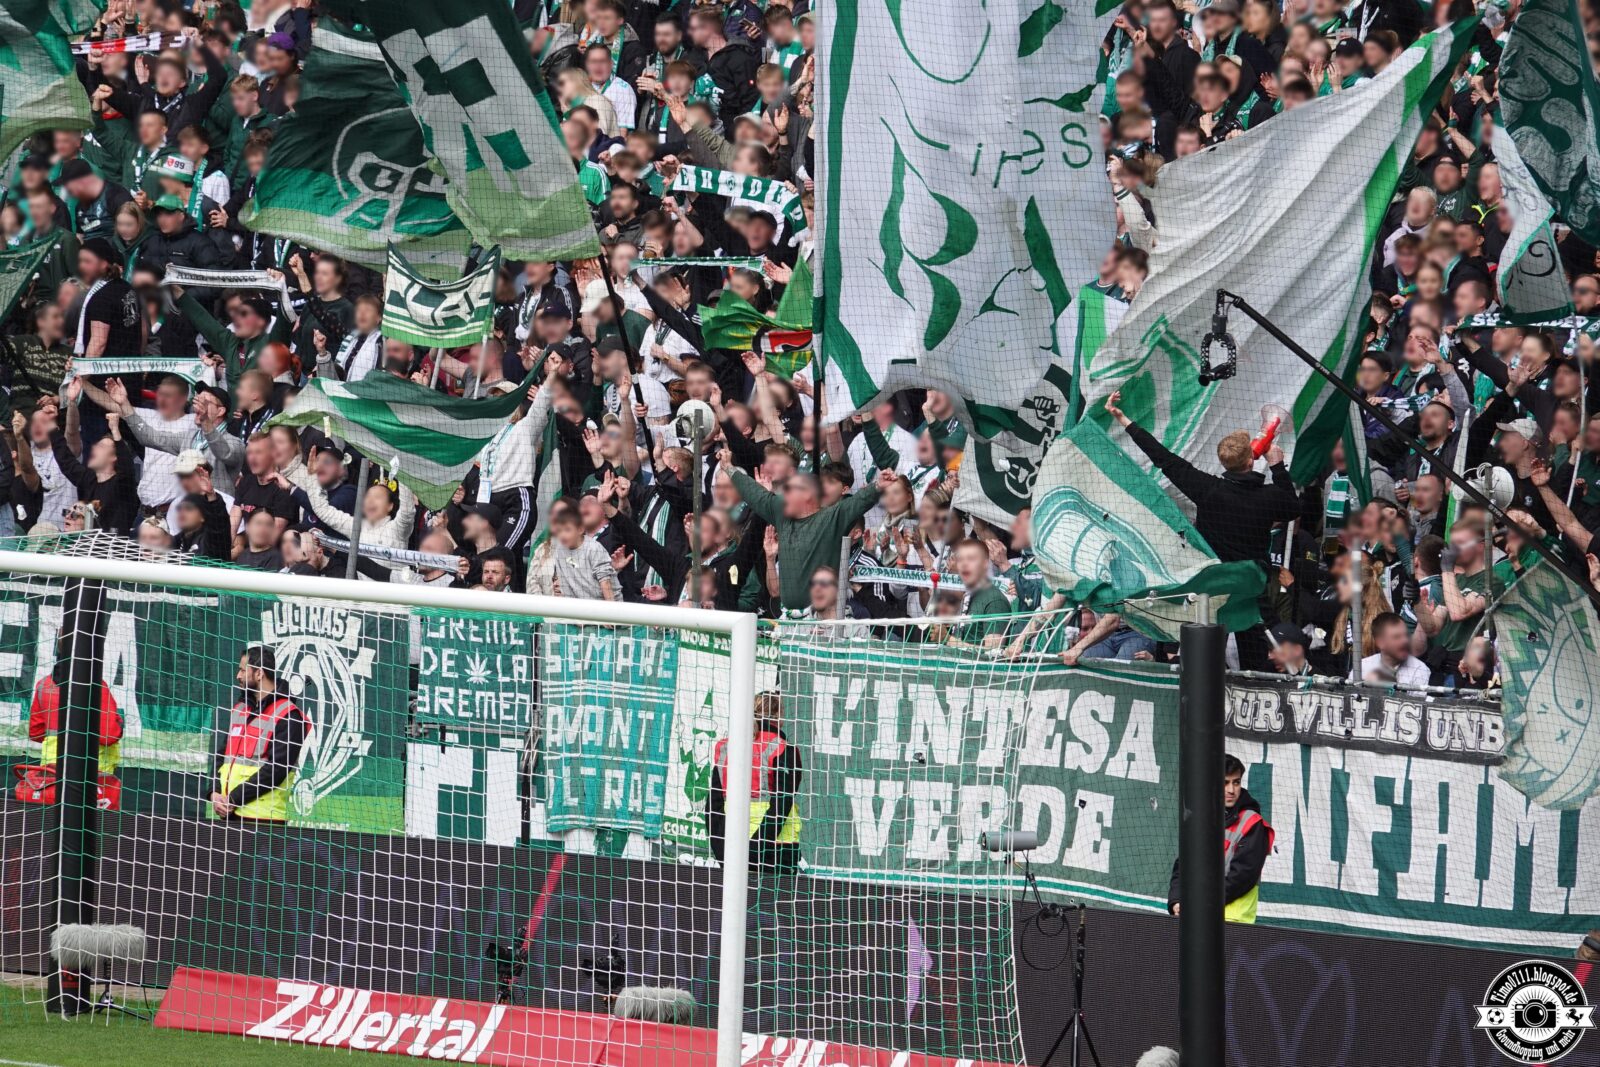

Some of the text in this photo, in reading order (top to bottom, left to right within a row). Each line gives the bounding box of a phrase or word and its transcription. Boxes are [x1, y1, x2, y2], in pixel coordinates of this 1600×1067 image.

[273, 601, 349, 640] ULTRAS
[680, 628, 710, 647] NON
[420, 645, 528, 684] DE LA
[416, 683, 532, 723] BREMEN
[1287, 691, 1380, 741] WILL
[1378, 700, 1423, 746] IS
[1426, 706, 1506, 754] UNB
[545, 704, 668, 753] AVANTI
[813, 674, 1161, 784] L'INTESA
[663, 821, 707, 841] CON LA
[844, 776, 1115, 874] VERDE
[246, 981, 507, 1063] Zillertal
